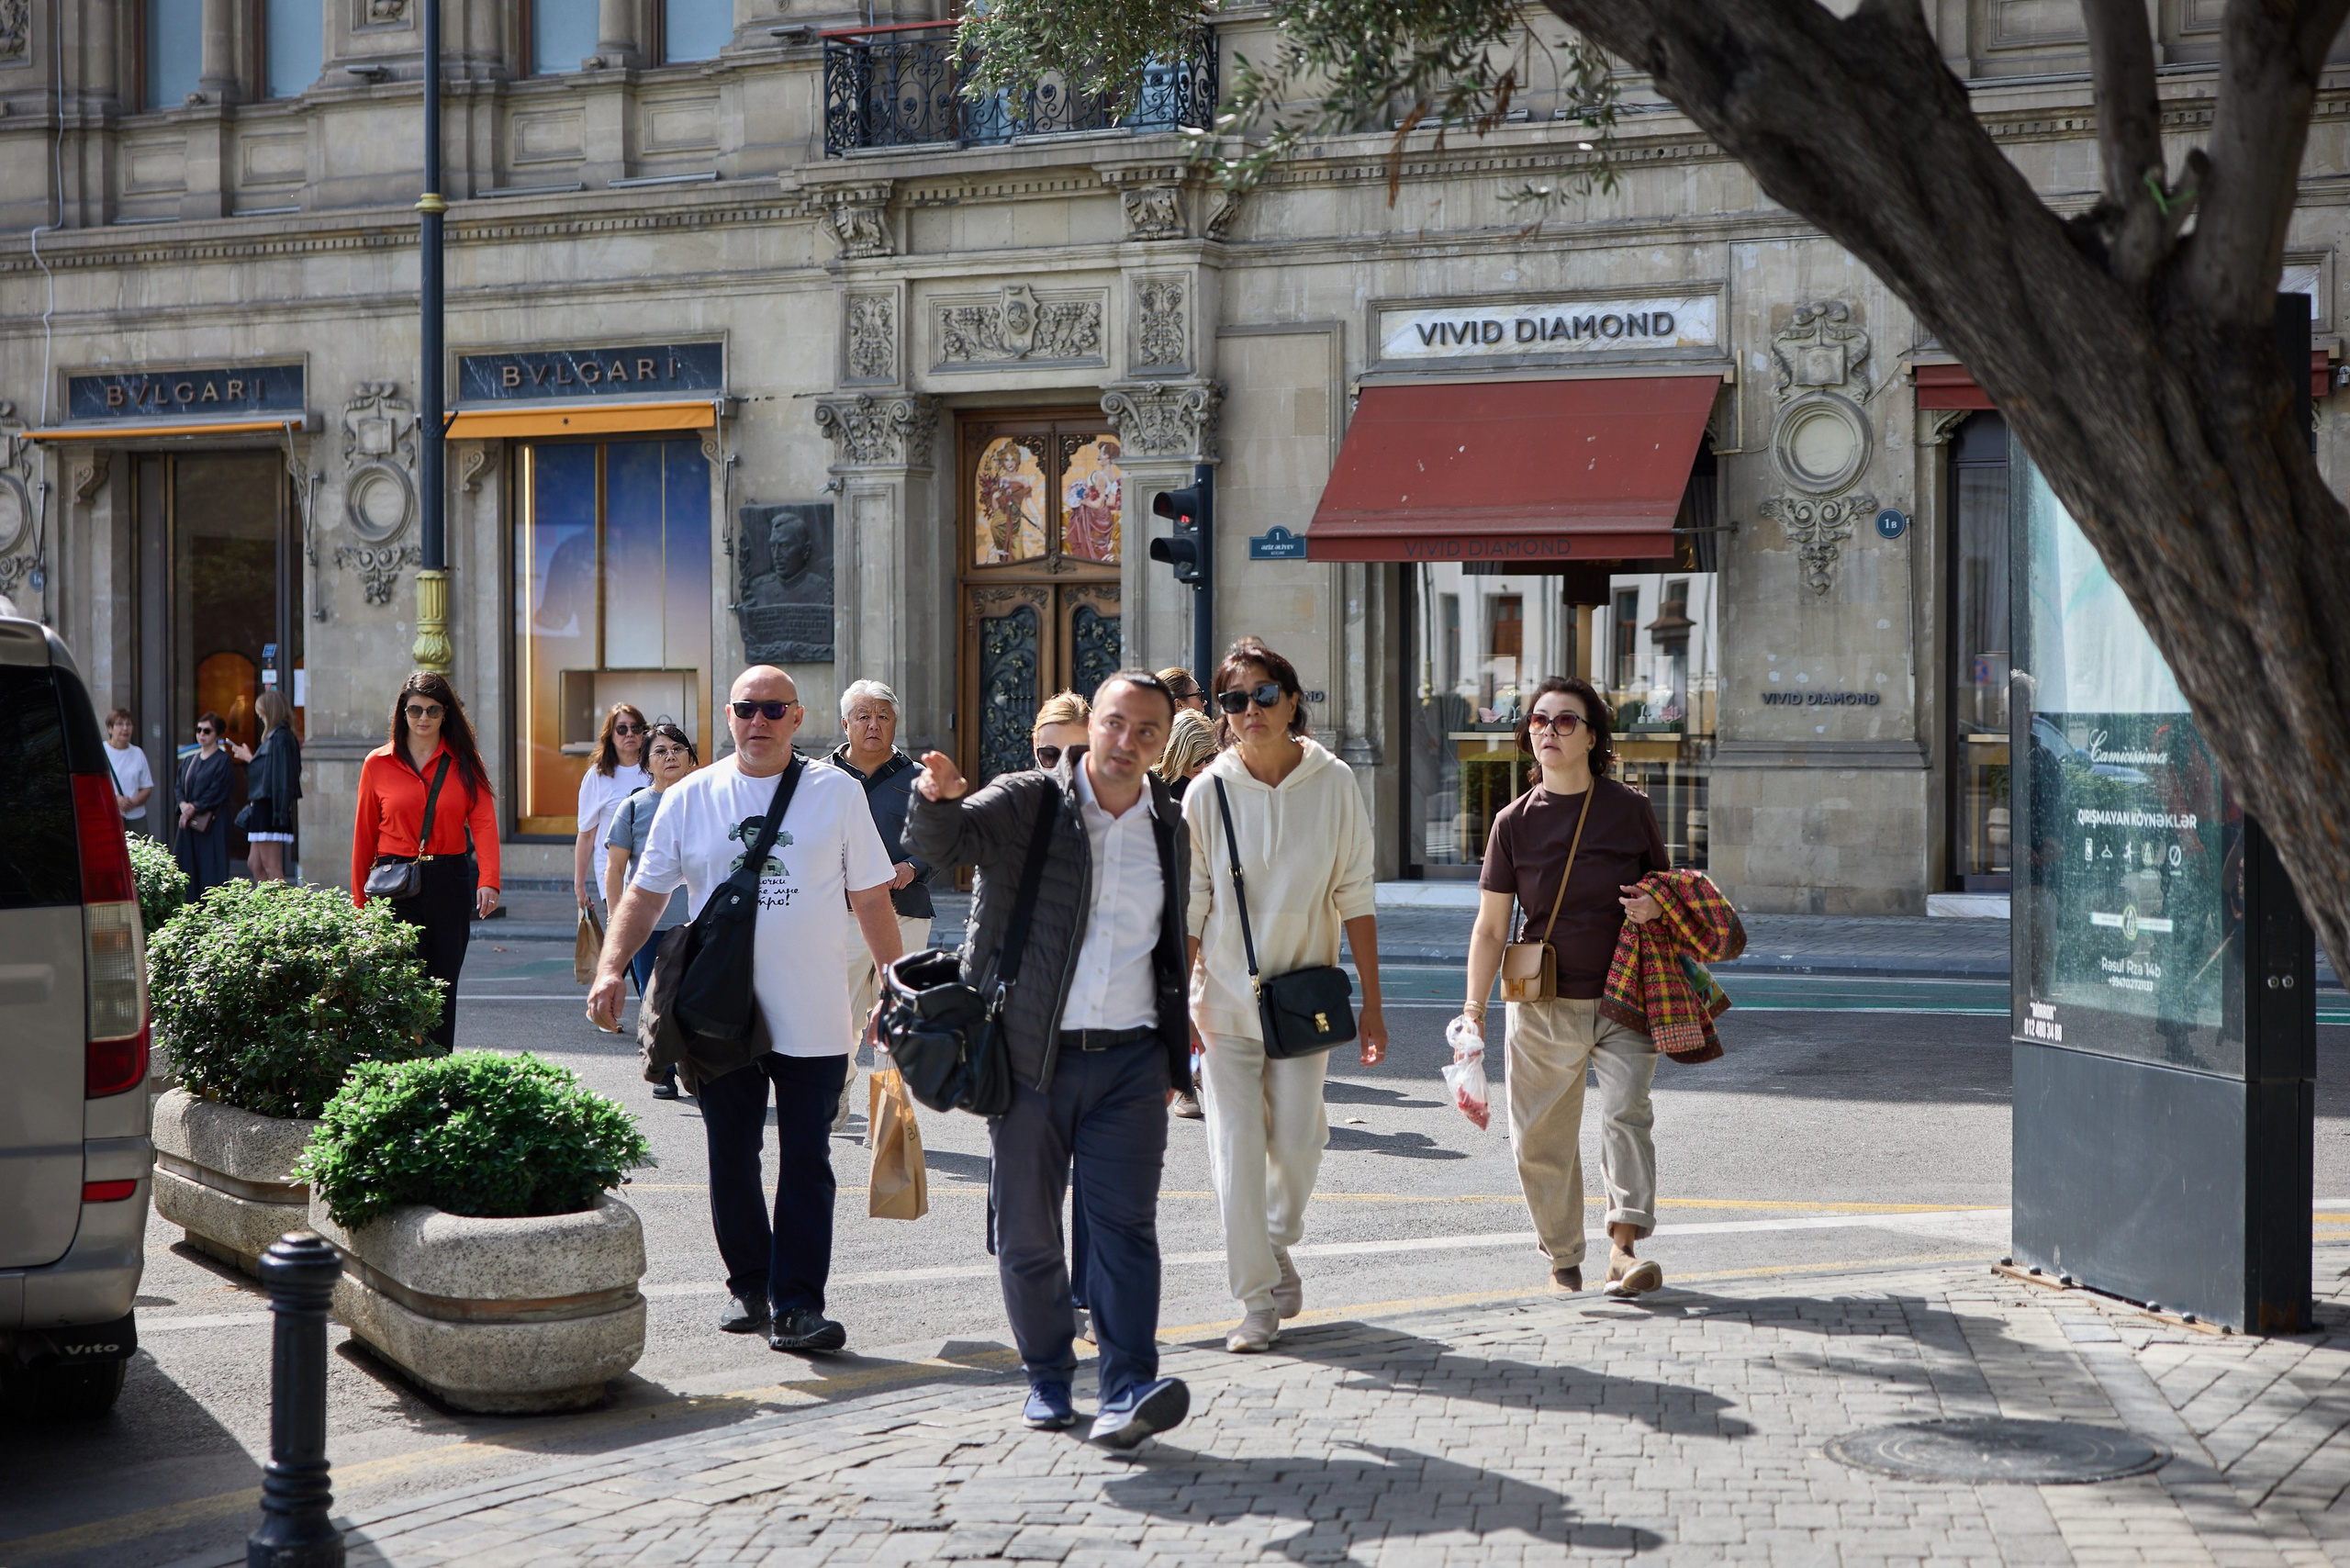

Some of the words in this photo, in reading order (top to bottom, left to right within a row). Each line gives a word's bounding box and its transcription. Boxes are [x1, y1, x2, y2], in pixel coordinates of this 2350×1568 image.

[1415, 319, 1504, 346] VIVID
[1515, 311, 1675, 342] DIAMOND
[502, 357, 677, 387] BVLGARI
[106, 378, 265, 407] BVLGARI
[1275, 532, 1280, 541] 1
[1405, 540, 1460, 557] VIVID
[1469, 533, 1572, 556] DIAMOND
[1762, 692, 1803, 705] VIVID
[1806, 691, 1880, 706] DIAMOND
[2089, 729, 2168, 764] Camicissima
[2127, 961, 2143, 976] Rza
[2145, 962, 2162, 979] 14b
[2024, 1017, 2035, 1036] 012
[64, 1343, 120, 1355] Vito
